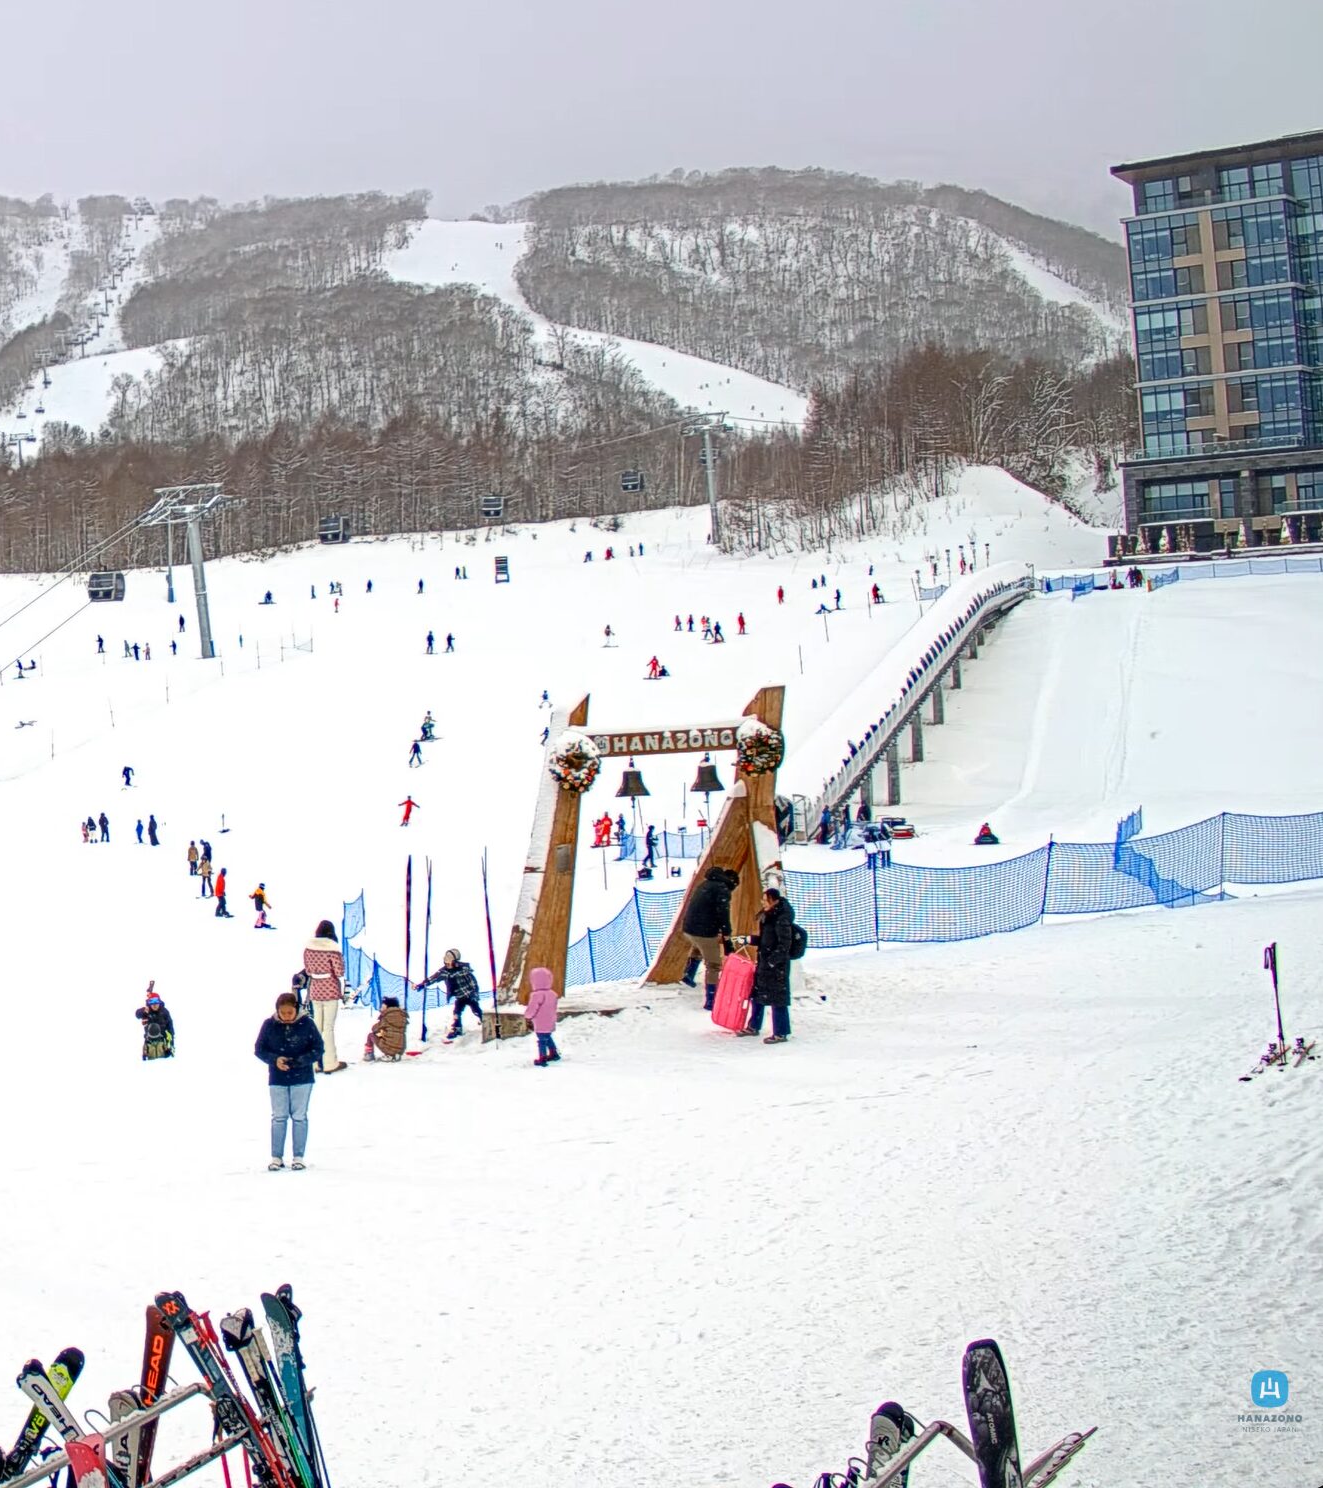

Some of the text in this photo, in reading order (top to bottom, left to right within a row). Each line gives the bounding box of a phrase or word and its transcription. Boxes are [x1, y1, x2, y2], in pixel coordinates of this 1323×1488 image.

[613, 728, 733, 753] HANAZONO
[144, 1335, 164, 1407] HEAD
[986, 1412, 998, 1444] ATOMIC
